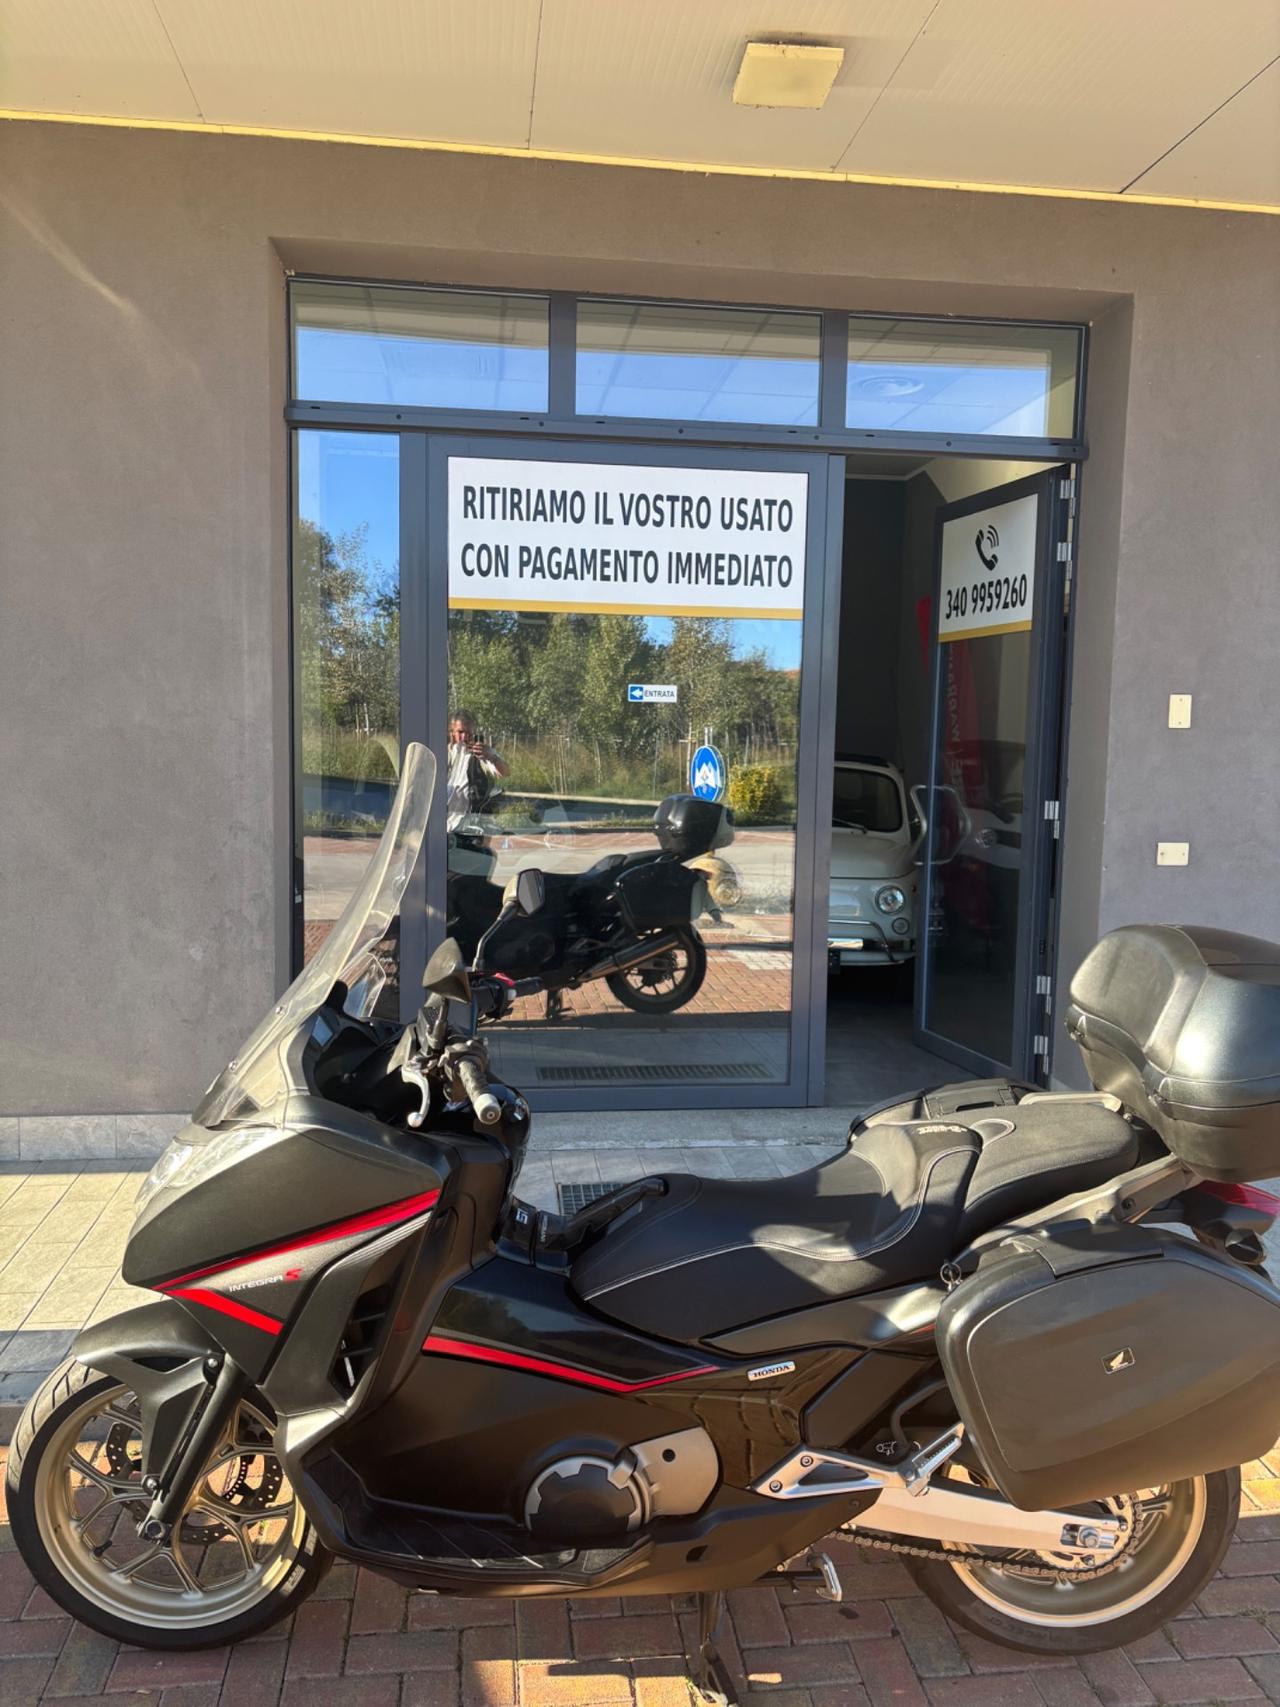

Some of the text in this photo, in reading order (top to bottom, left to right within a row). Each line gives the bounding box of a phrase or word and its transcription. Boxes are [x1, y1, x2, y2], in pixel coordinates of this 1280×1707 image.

[463, 485, 793, 533] RITIRIAMO IL VOSTRO USATO
[460, 542, 793, 588] CON PAGAMENTO IMMEDIATO
[945, 573, 1027, 620] 340 9959260
[644, 689, 675, 698] ENTRATA
[229, 1268, 304, 1292] INTEGRA S
[753, 1364, 790, 1378] HONDA
